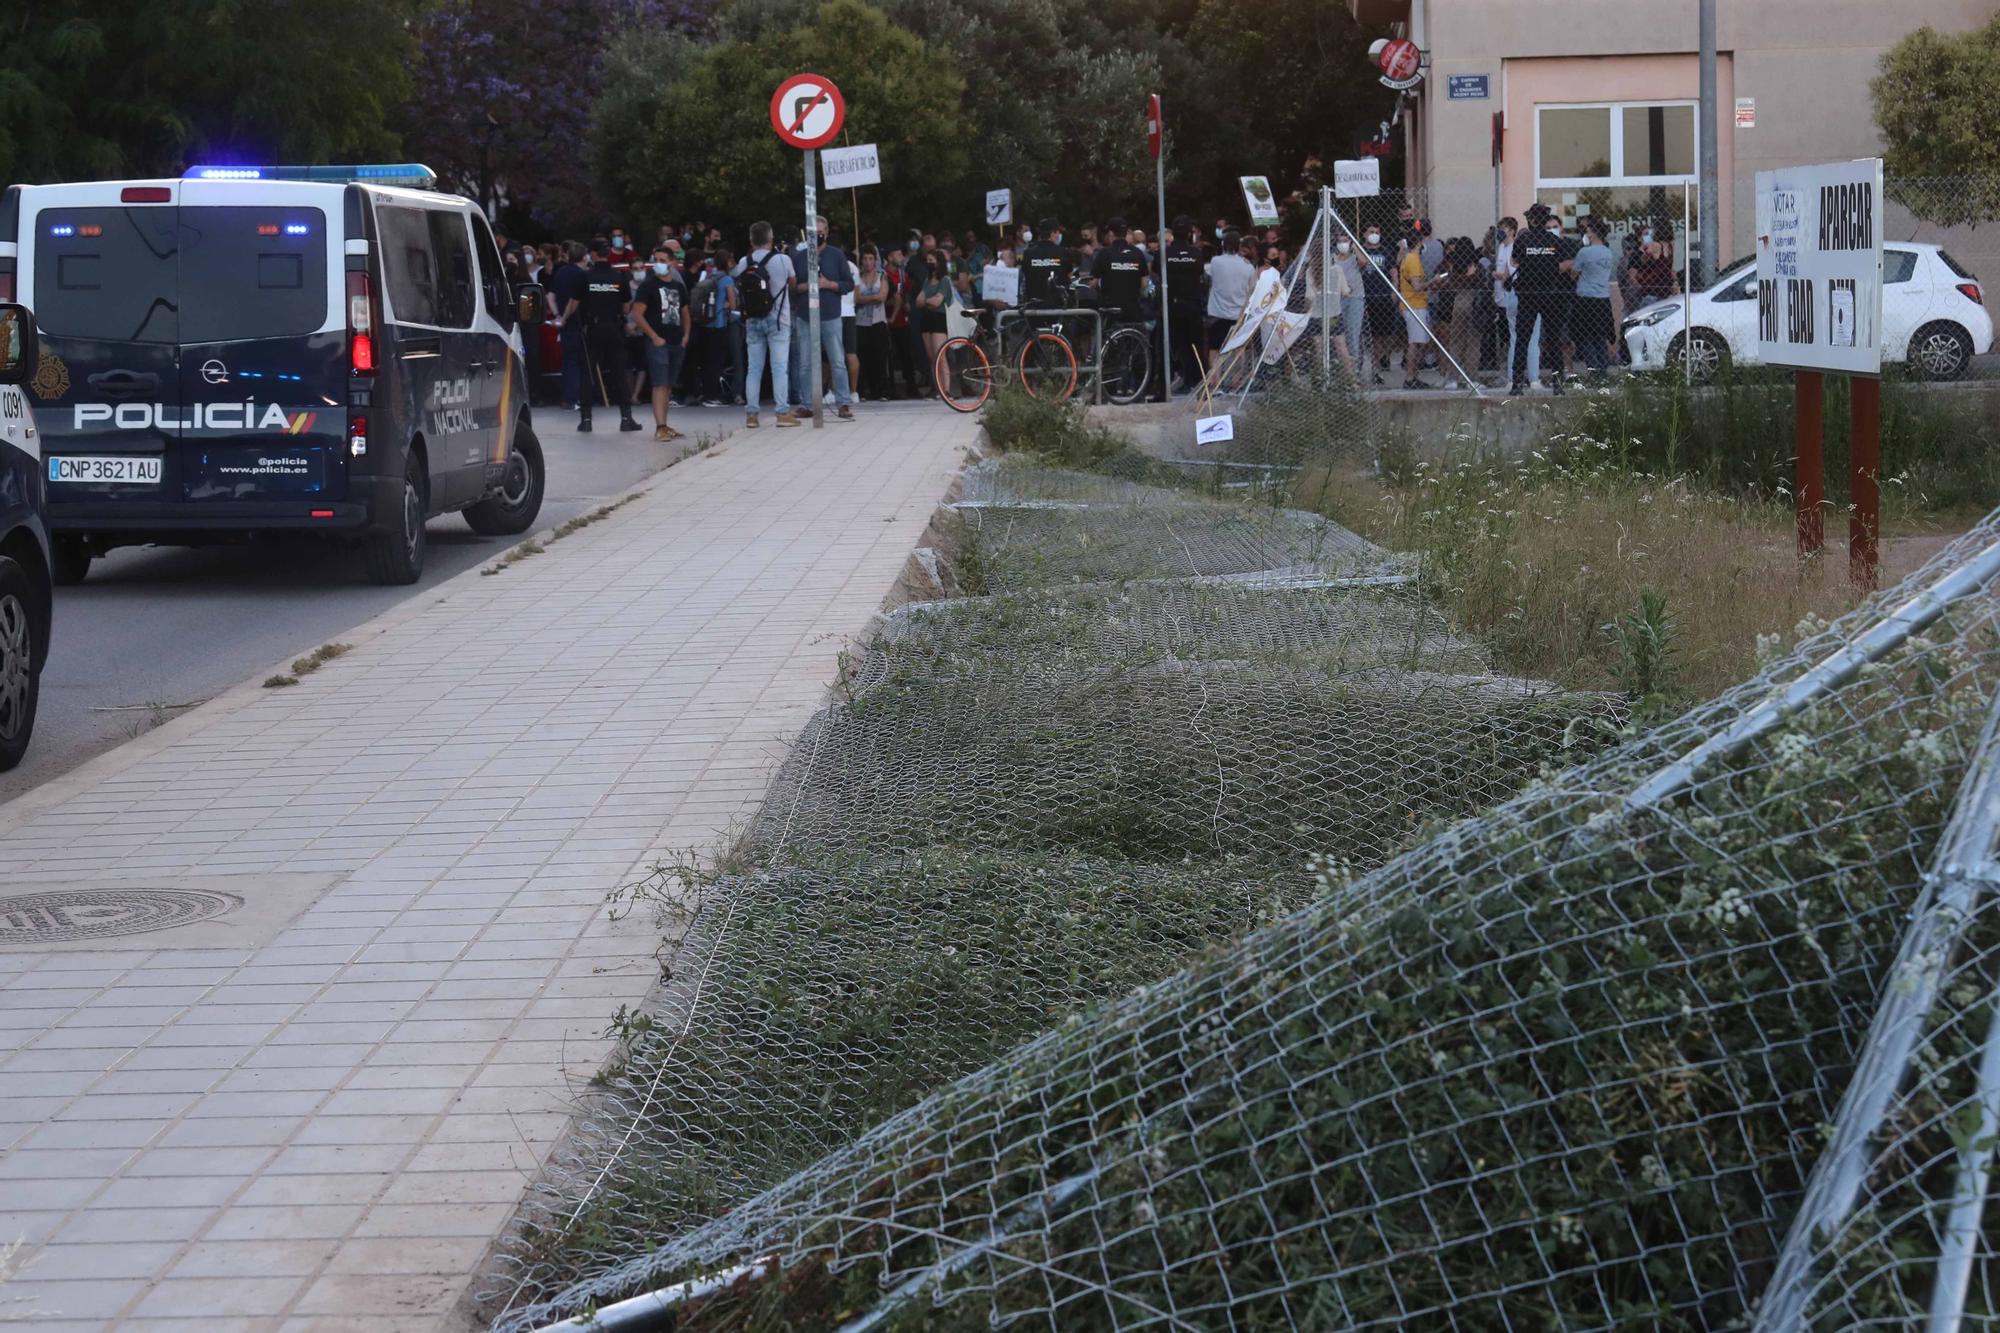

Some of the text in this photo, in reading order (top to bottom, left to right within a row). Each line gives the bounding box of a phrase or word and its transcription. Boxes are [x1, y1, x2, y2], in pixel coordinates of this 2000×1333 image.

[1819, 181, 1873, 251] APARCAR
[74, 395, 291, 430] POLICÍA
[433, 407, 479, 436] NACIONAL
[220, 466, 309, 475] www.policia.es
[258, 457, 308, 467] @policia
